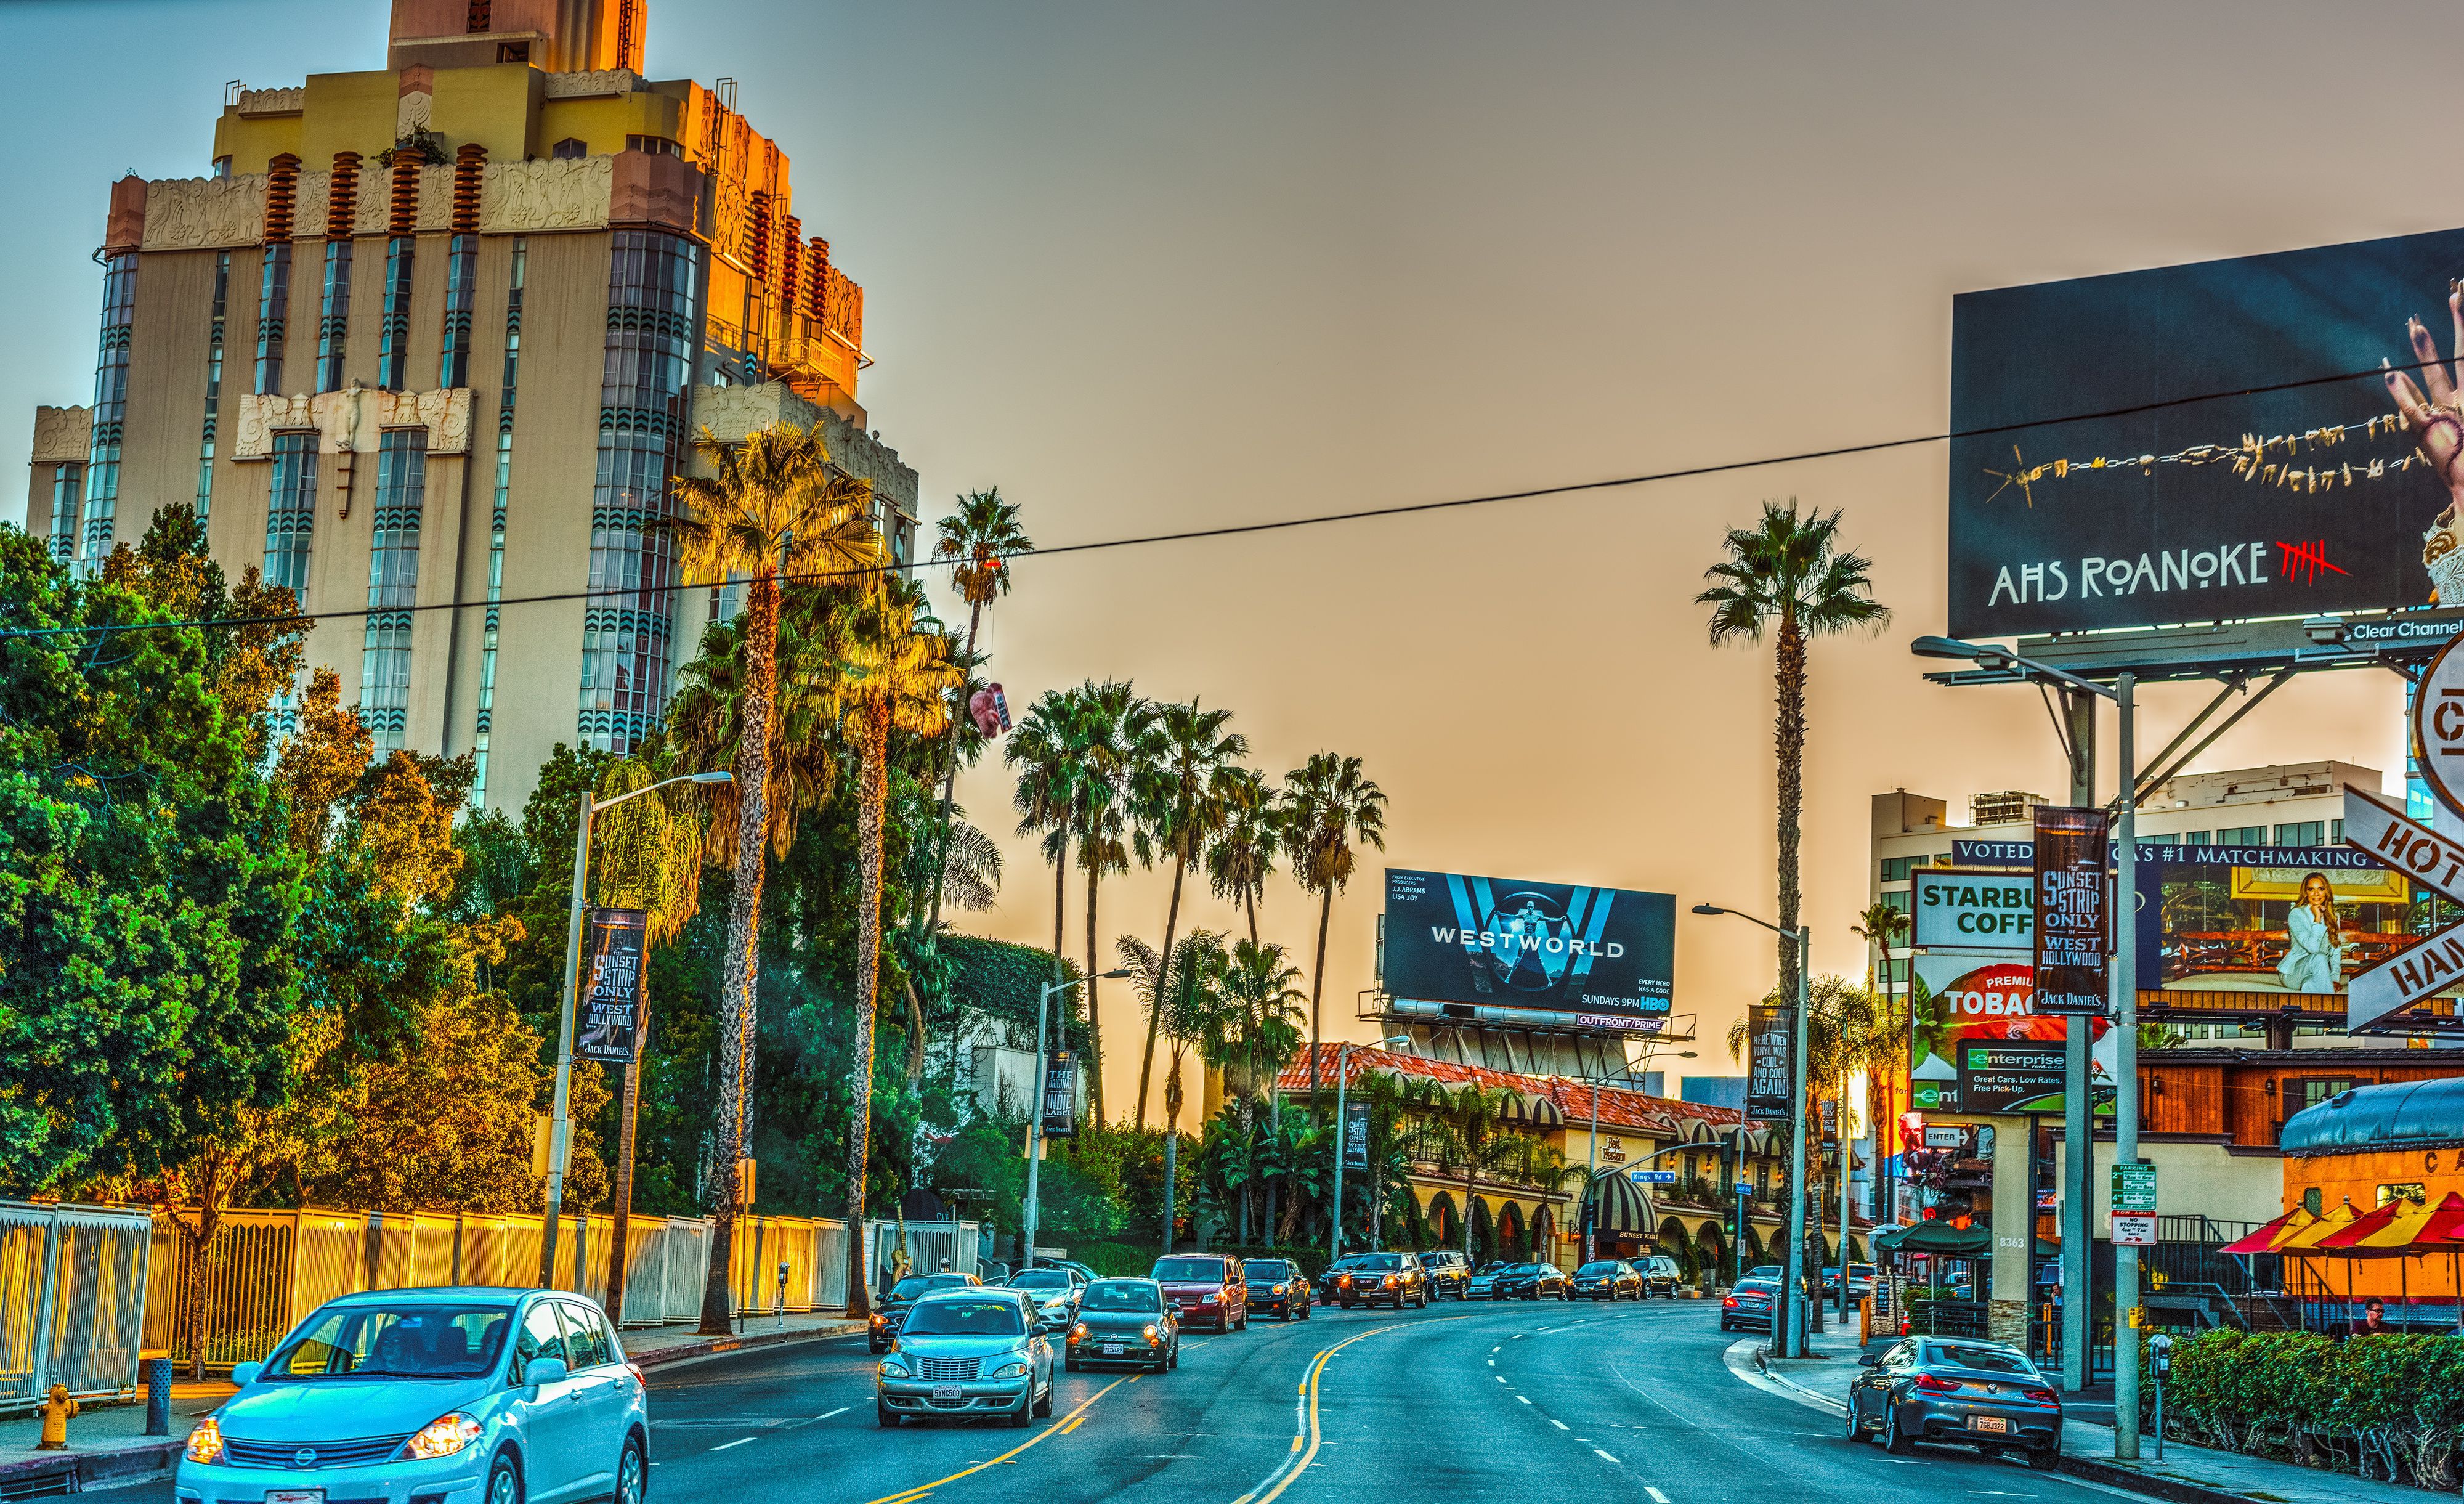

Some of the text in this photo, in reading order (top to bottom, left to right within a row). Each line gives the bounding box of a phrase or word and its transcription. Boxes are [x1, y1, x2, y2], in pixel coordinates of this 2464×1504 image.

[1988, 541, 2269, 608] AHS ROANOKE
[2353, 619, 2463, 639] Clear Channel
[1958, 842, 2033, 859] VOTED
[2162, 846, 2184, 863] #1
[2196, 847, 2367, 866] MATCHMAKING
[2043, 871, 2102, 906] SUNSET
[1923, 885, 2033, 909] STARB
[2058, 888, 2099, 913] STRIP
[1957, 912, 2033, 934] COFF
[2045, 913, 2101, 929] ONLY
[1432, 926, 1624, 958] WESTWORLD
[2044, 935, 2101, 951] WEST
[2041, 949, 2101, 967] HOLLYWOOD
[593, 955, 638, 982] SUNSET
[604, 967, 635, 987] STRIP
[1986, 976, 2033, 988] PREMIU
[593, 986, 634, 999] ONLY
[2041, 991, 2064, 1005] JACK
[591, 1001, 633, 1015] WEST
[1582, 994, 1669, 1012] SUNDAYS 9PM HBO
[1944, 991, 2033, 1015] TOBA
[588, 1013, 632, 1027] HOLLYWOOD
[1754, 1033, 1787, 1046] HERE WHEN
[585, 1043, 602, 1054] JACK
[1754, 1046, 1786, 1058] VINYL WAS
[1762, 1056, 1778, 1068] COOL
[1969, 1053, 2065, 1067] enterprise
[1049, 1070, 1073, 1080] THE
[1753, 1066, 1786, 1079] AND COOL
[1997, 1076, 2018, 1084] Cars.
[1048, 1079, 1072, 1089] ORIGINAL
[1751, 1078, 1786, 1095] AGAIN
[1992, 1084, 2025, 1093] Pick-Up.
[1047, 1094, 1072, 1110] INDIE
[2000, 1237, 2025, 1248] 8363
[1979, 1421, 2004, 1431] 7GBJ322
